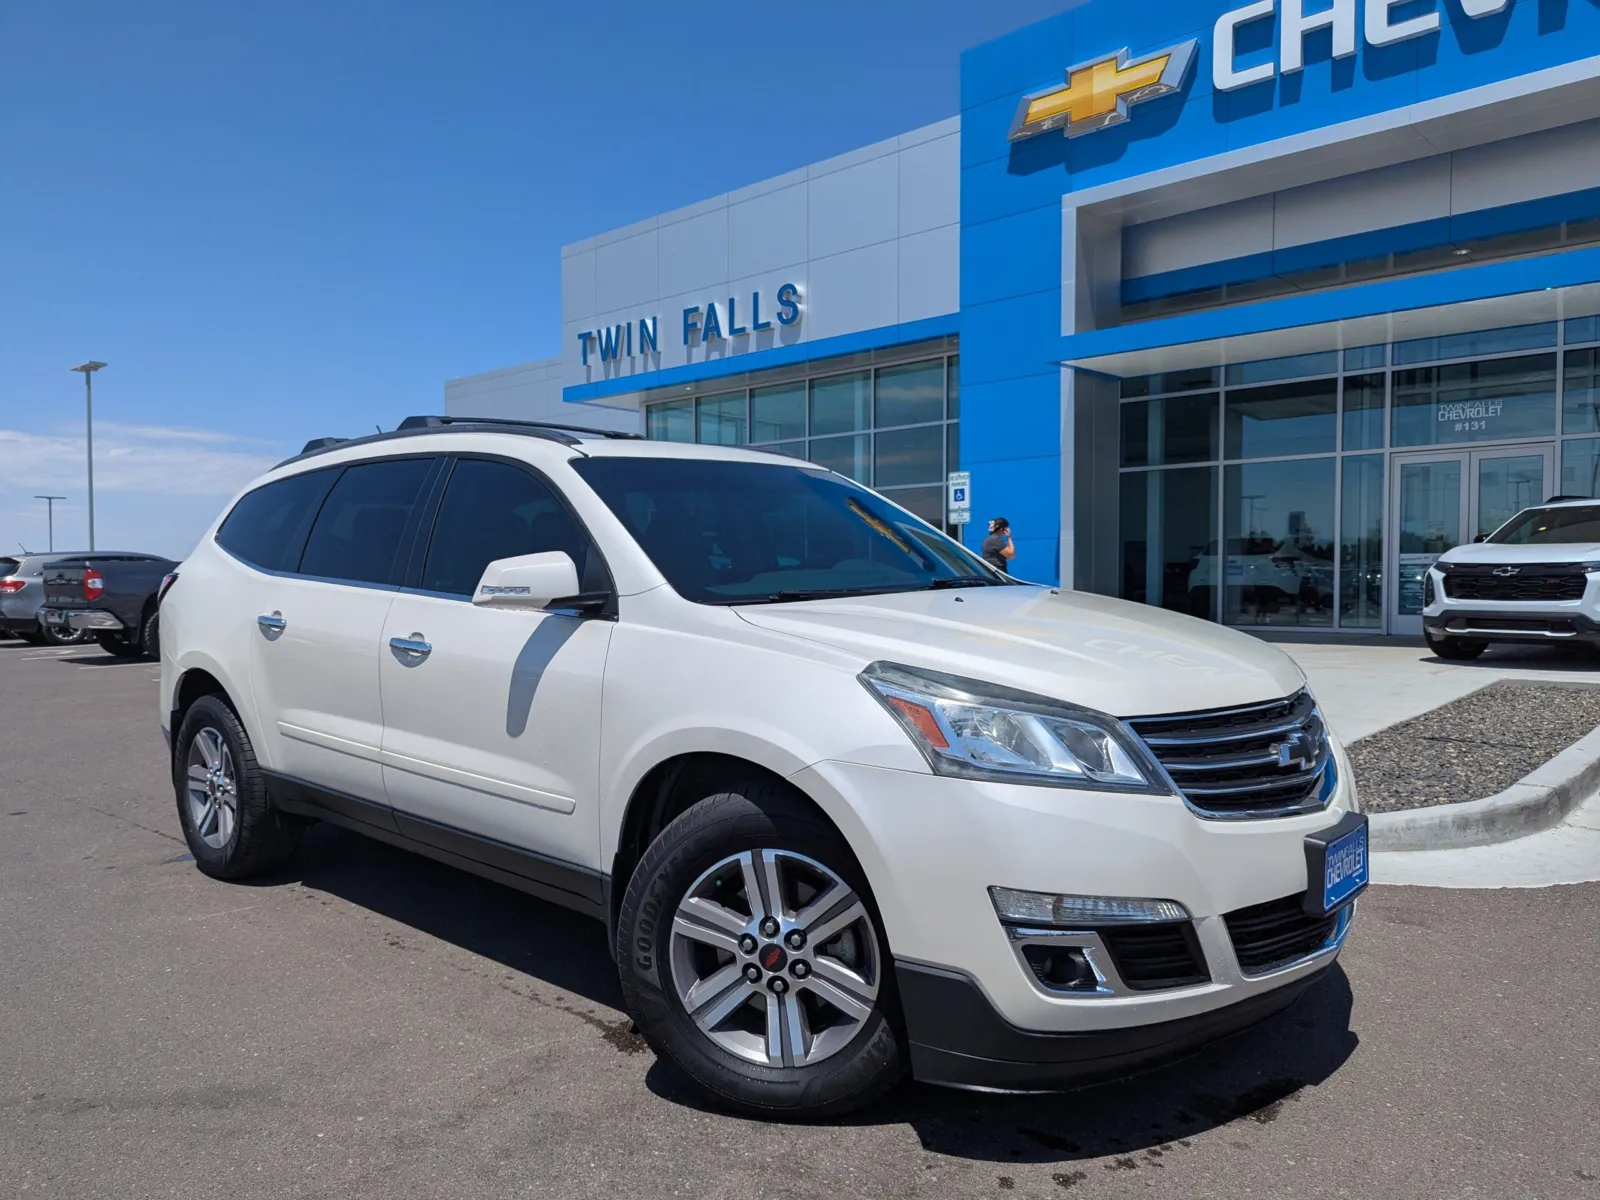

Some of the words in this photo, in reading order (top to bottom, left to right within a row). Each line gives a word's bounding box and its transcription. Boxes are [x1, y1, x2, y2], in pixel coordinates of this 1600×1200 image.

[1213, 0, 1509, 92] CHE
[577, 316, 658, 366] TWIN
[683, 283, 802, 346] FALLS
[1438, 406, 1503, 421] CHEVROLET
[1454, 420, 1486, 432] #131
[1326, 847, 1364, 889] CHEVROLET
